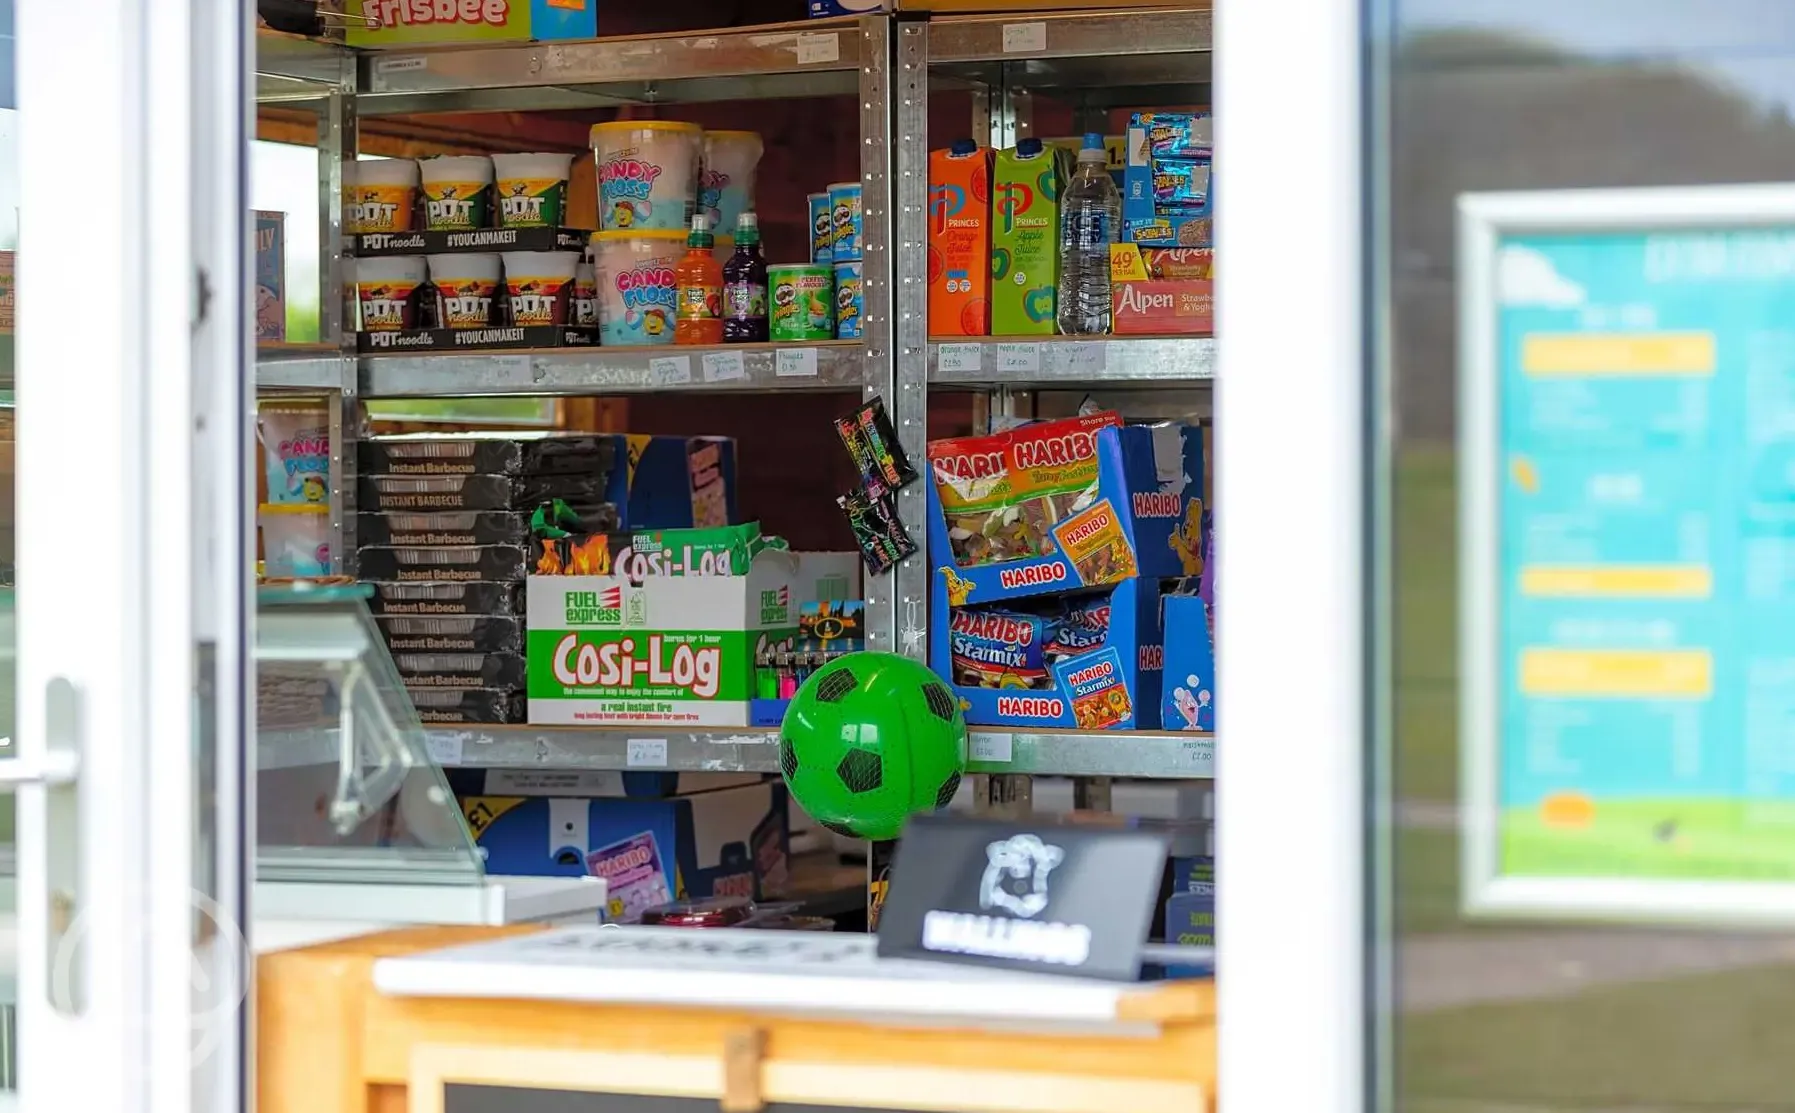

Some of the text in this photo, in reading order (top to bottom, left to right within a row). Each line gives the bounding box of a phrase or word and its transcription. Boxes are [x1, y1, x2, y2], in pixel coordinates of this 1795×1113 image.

[428, 200, 474, 220] POT
[501, 196, 545, 217] POT
[948, 219, 979, 227] PRINCES
[1016, 218, 1048, 226] PRINCES
[447, 231, 516, 247] #YOUCANMAKEIT
[362, 299, 407, 320] POT
[445, 297, 491, 318] POT
[511, 295, 556, 318] POT
[1115, 283, 1174, 316] Alpen
[455, 328, 525, 346] #YOUCANMAKEIT
[389, 462, 476, 473] Instant Barbecue
[380, 495, 463, 507] INSTANT BARBECUE
[1132, 491, 1181, 518] HARIBO
[390, 533, 476, 544] Instant Barbecue
[1065, 513, 1109, 547] HARIBO
[398, 569, 482, 580] Instant Barbecue
[1001, 561, 1066, 589] HARIBO
[384, 602, 466, 613] Instant Barbecue
[565, 590, 600, 608] FUEL
[761, 590, 777, 606] FUEL
[565, 608, 621, 623] express
[952, 609, 1034, 648] HARIBO
[390, 638, 475, 649] Instant Barbecue
[954, 637, 1023, 668] Starmix
[552, 632, 721, 699] Cosi-Log
[1068, 660, 1113, 687] HARIBO
[403, 675, 484, 686] nstant Barbecue
[1075, 676, 1114, 697] Starmix
[608, 702, 625, 712] real
[627, 702, 655, 712] instant
[658, 702, 673, 713] fire
[998, 697, 1064, 719] HARIBO
[595, 845, 652, 878] HARIBO
